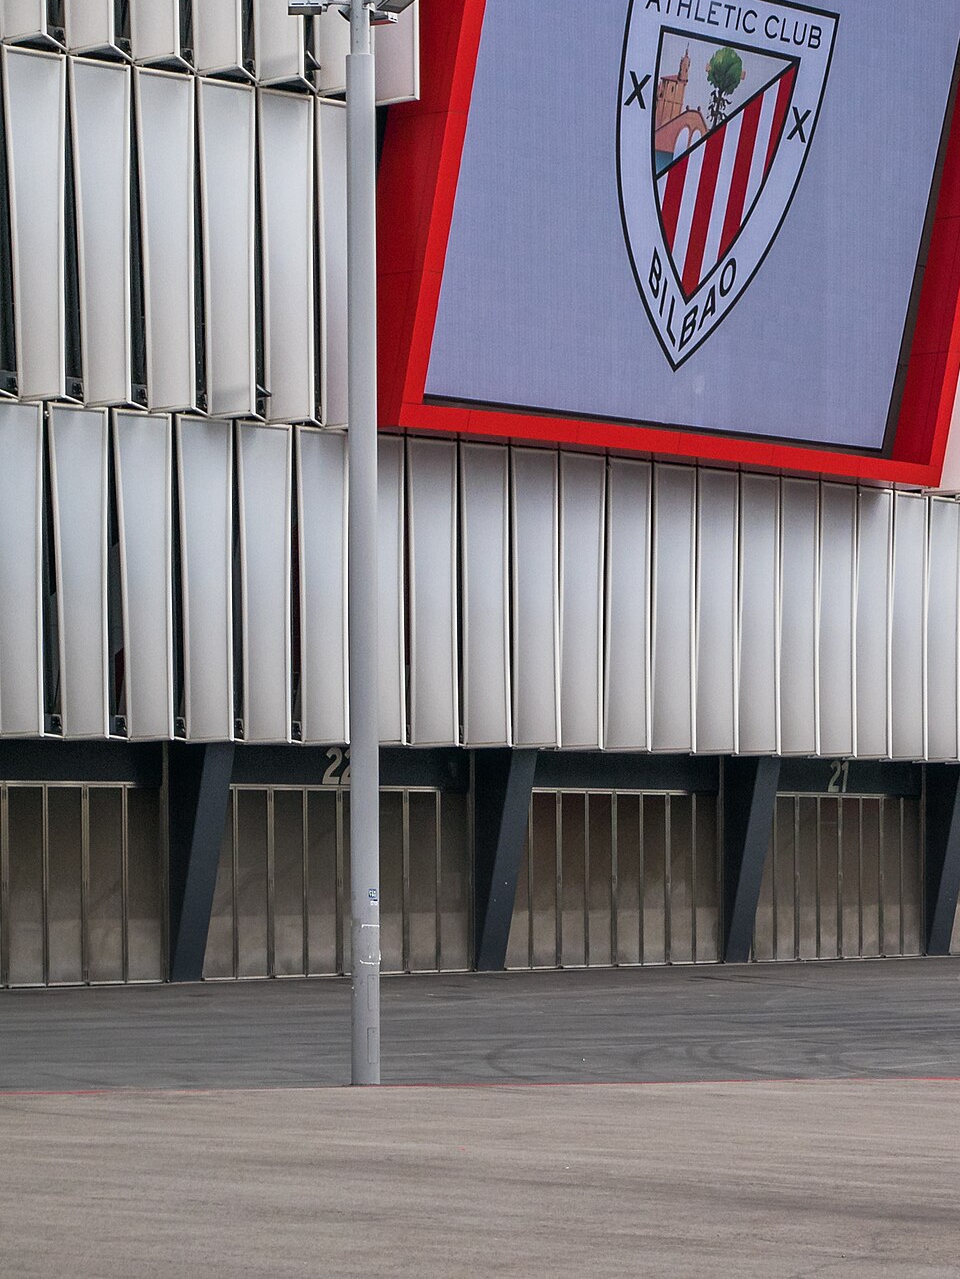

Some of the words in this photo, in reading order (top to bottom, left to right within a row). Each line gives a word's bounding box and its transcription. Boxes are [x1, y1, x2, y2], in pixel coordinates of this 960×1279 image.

[765, 15, 823, 50] CLUB
[648, 246, 738, 352] BILBAO
[827, 760, 849, 793] 21
